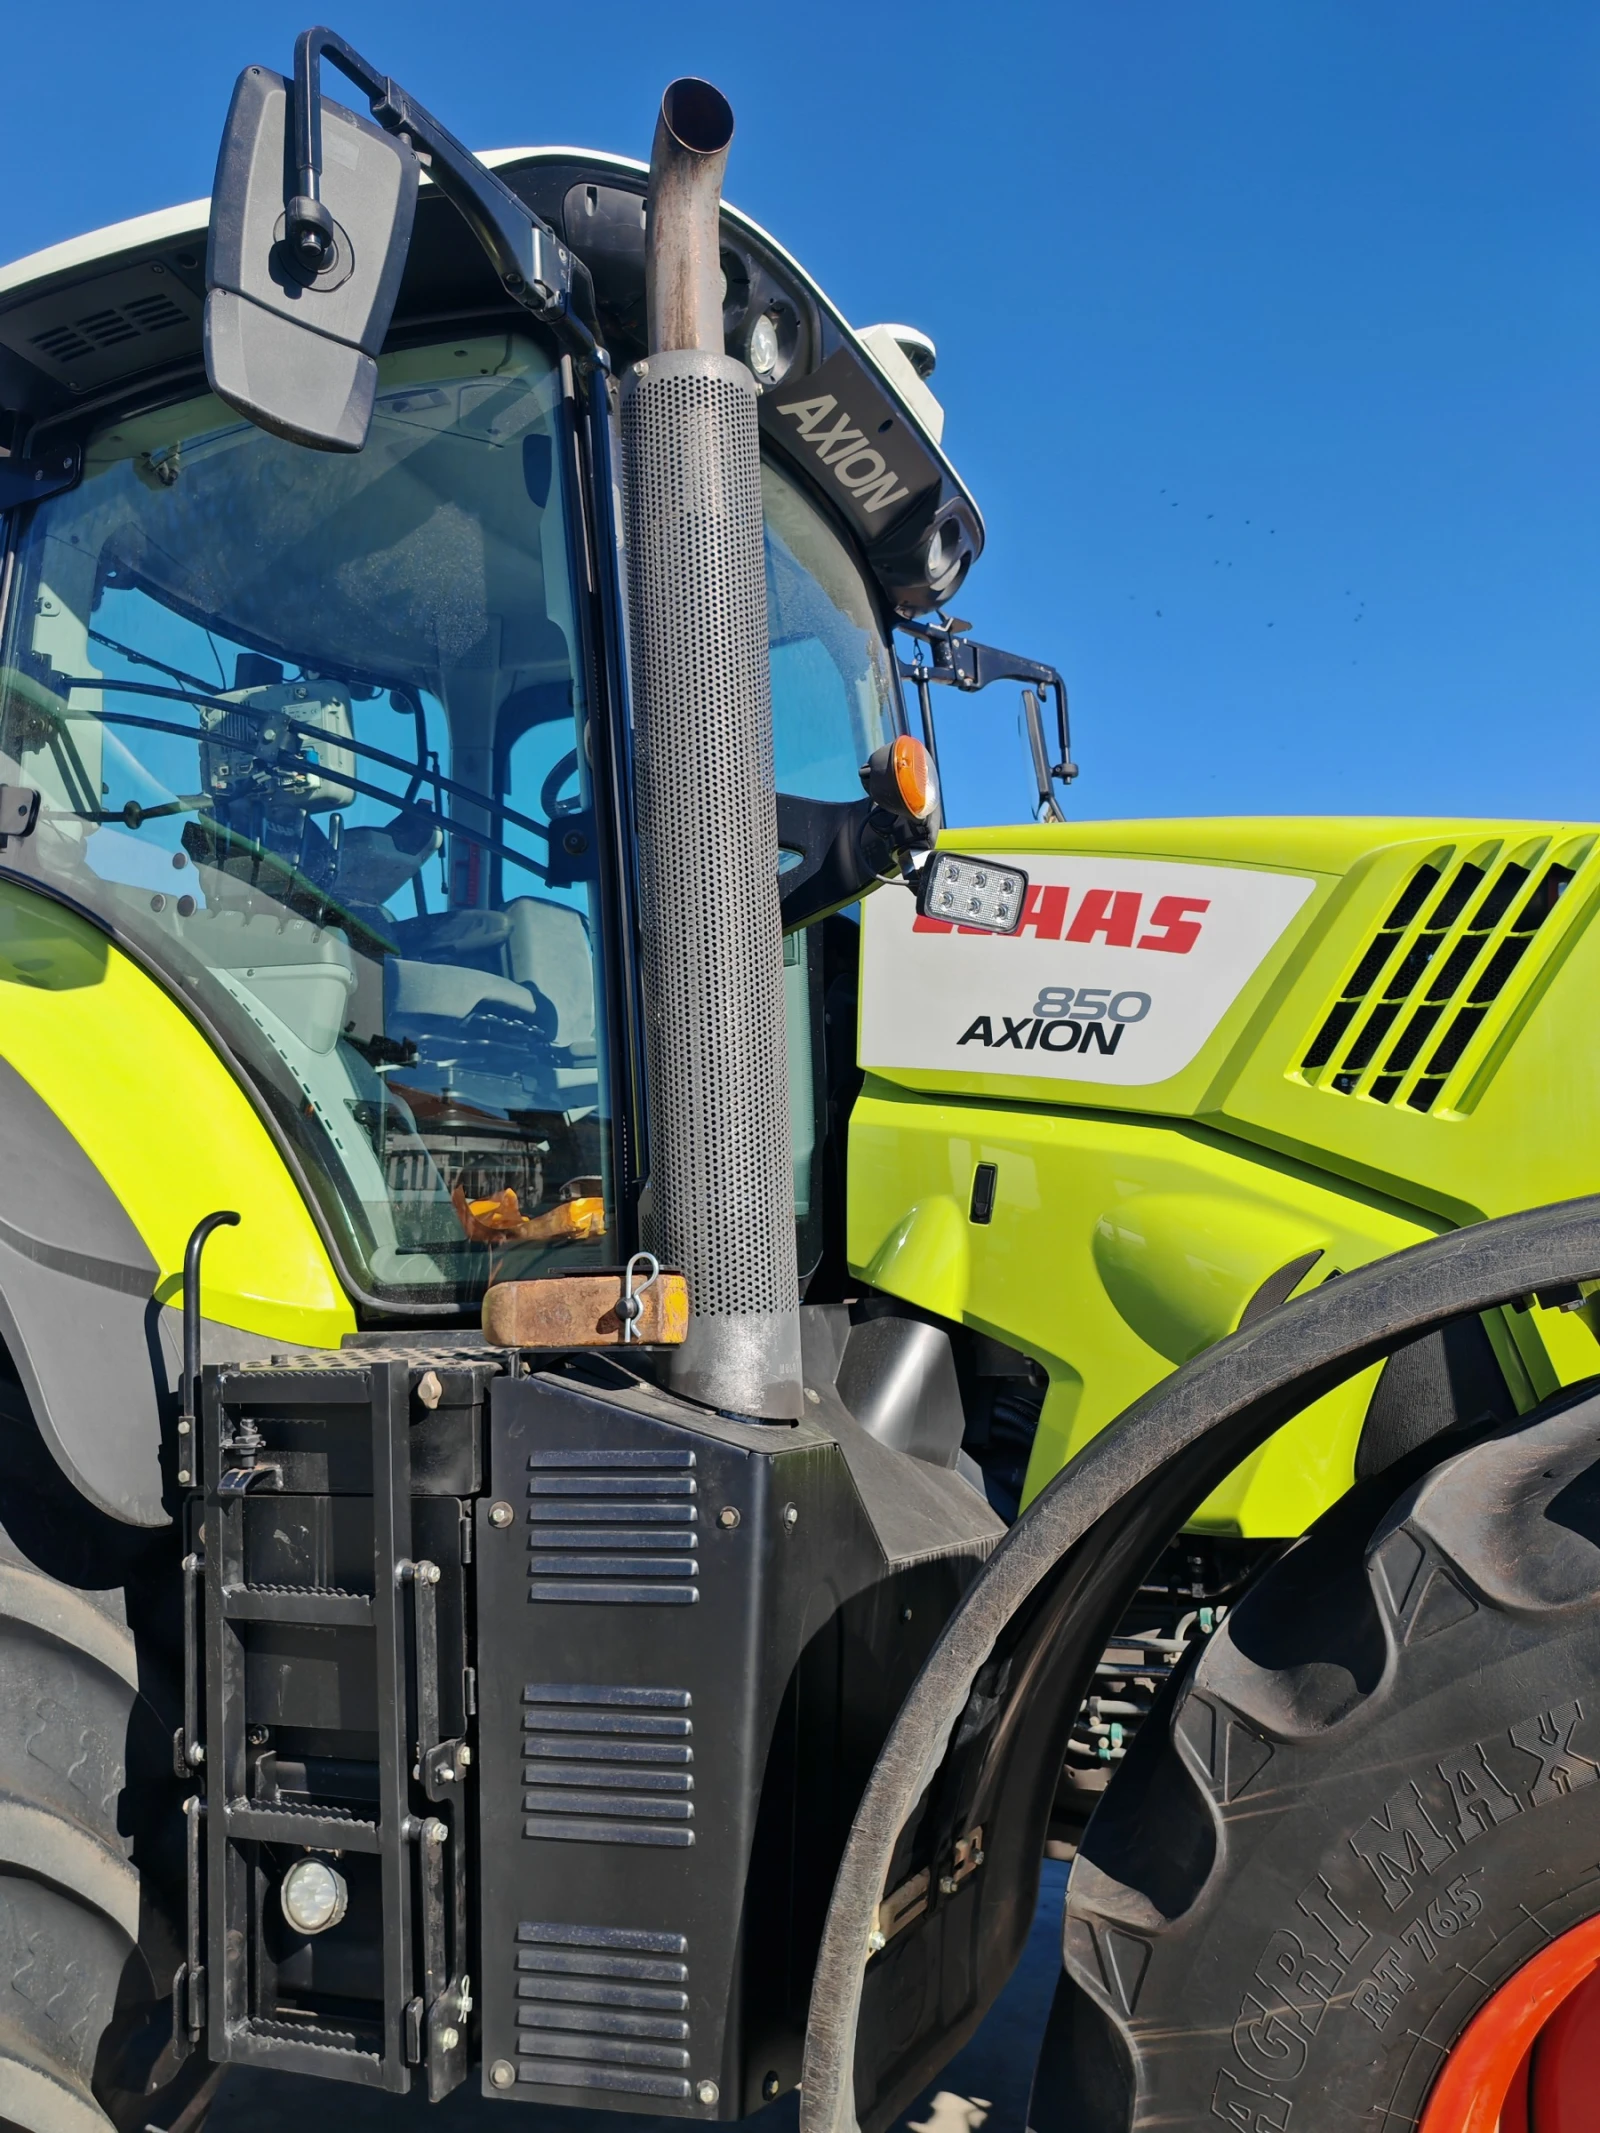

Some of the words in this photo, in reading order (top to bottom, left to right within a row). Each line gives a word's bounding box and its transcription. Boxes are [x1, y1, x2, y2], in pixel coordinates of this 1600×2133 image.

[776, 394, 909, 513] AXION
[912, 885, 1211, 954] AAS
[957, 1016, 1125, 1055] AXION
[1033, 987, 1151, 1022] 850
[1350, 1946, 1416, 2032] RT
[1400, 1868, 1485, 1963] 765
